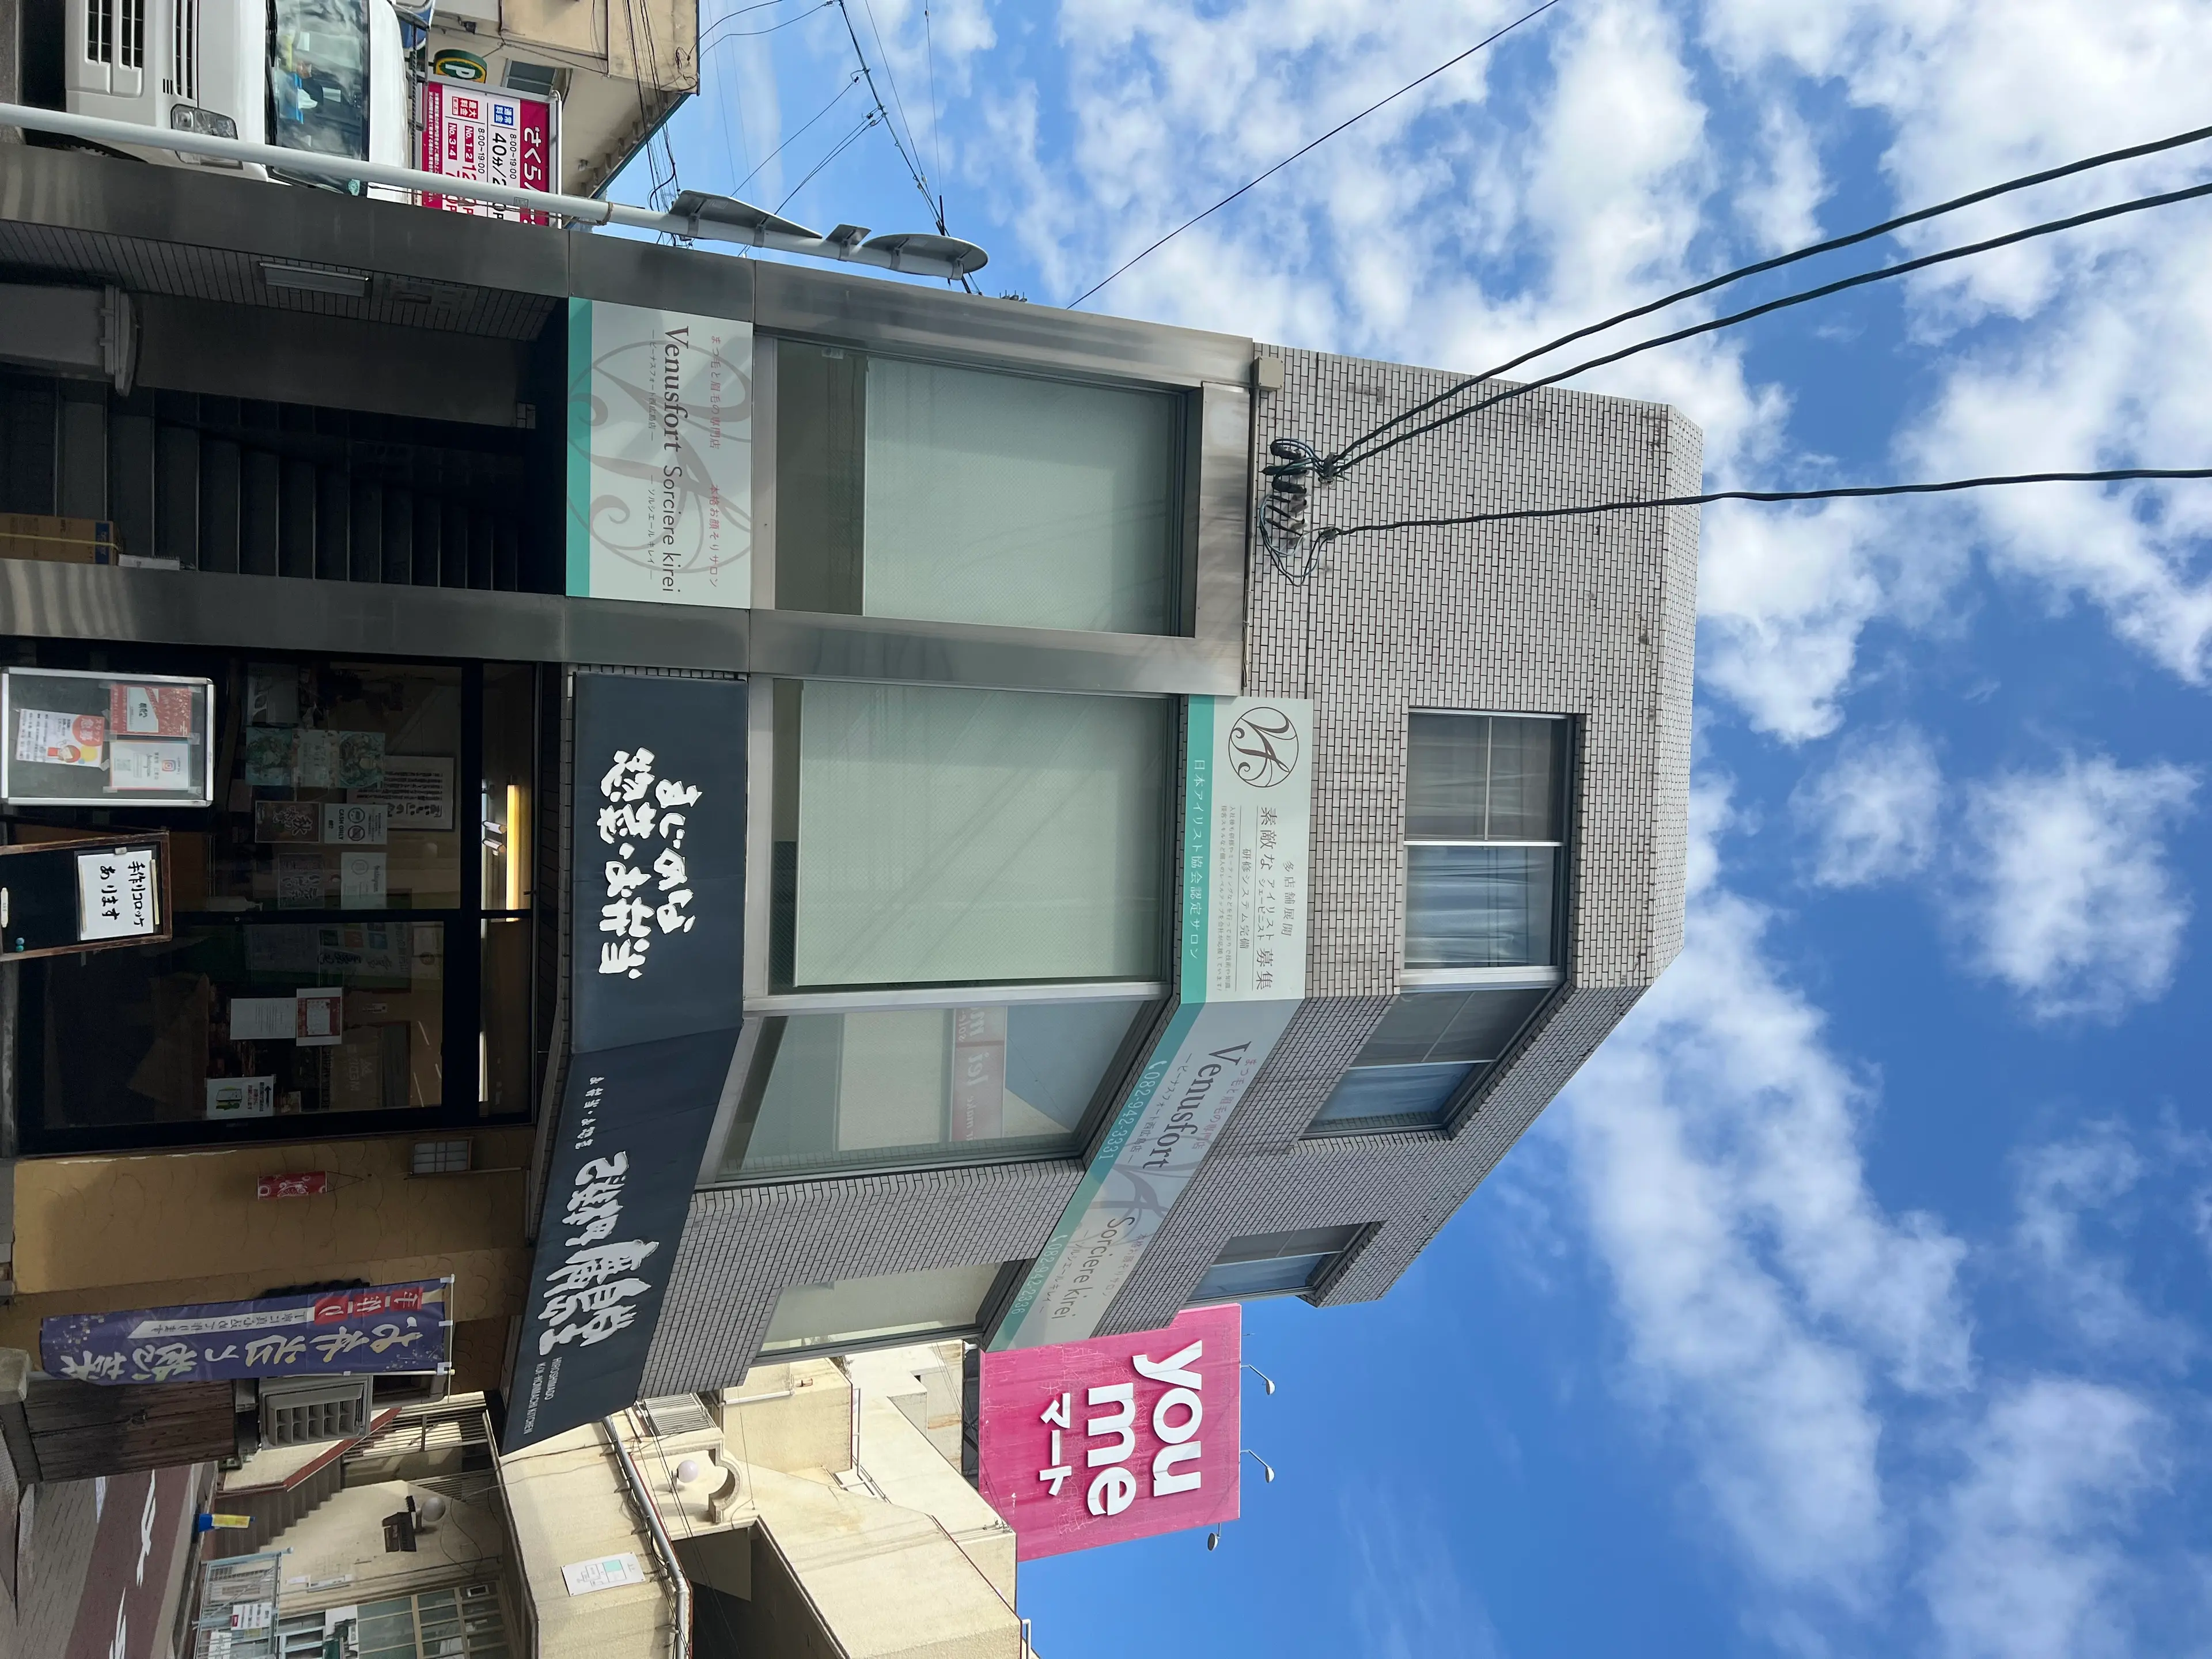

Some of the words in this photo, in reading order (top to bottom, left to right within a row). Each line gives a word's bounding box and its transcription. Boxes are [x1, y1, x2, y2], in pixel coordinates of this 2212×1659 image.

[445, 63, 476, 78] P
[663, 326, 689, 452] Venusfort
[709, 335, 722, 449] まつ毛と眉毛の専門店
[662, 465, 683, 546] Sorciere
[709, 484, 720, 587] 本格お顔そりサロン
[662, 552, 681, 592] kirei
[596, 747, 656, 980] 惣菜・お弁当
[654, 779, 703, 934] まじめな
[1189, 759, 1206, 960] 日本アイリスト協会認定サロン
[1259, 807, 1277, 870] 素敵な
[99, 865, 119, 921] あります
[126, 860, 147, 927] 手作りコロッケ
[1238, 848, 1252, 949] 研修システム完備
[1266, 878, 1275, 941] アイリスト
[1281, 861, 1296, 936] 多店舗展開
[1255, 948, 1274, 990] 募集
[1099, 1070, 1161, 1161] 082-942-3331
[1142, 1041, 1252, 1170] Venusfort
[1191, 1058, 1258, 1150] まつ毛と眉毛の専門店
[1011, 1244, 1062, 1315] 082-942-2336
[1073, 1217, 1136, 1283] Sorciere
[1051, 1287, 1089, 1320] kirei
[544, 1357, 562, 1400] HIROSHIMADO
[1132, 1340, 1203, 1497] you
[1039, 1393, 1073, 1497] マート
[1086, 1382, 1137, 1516] me
